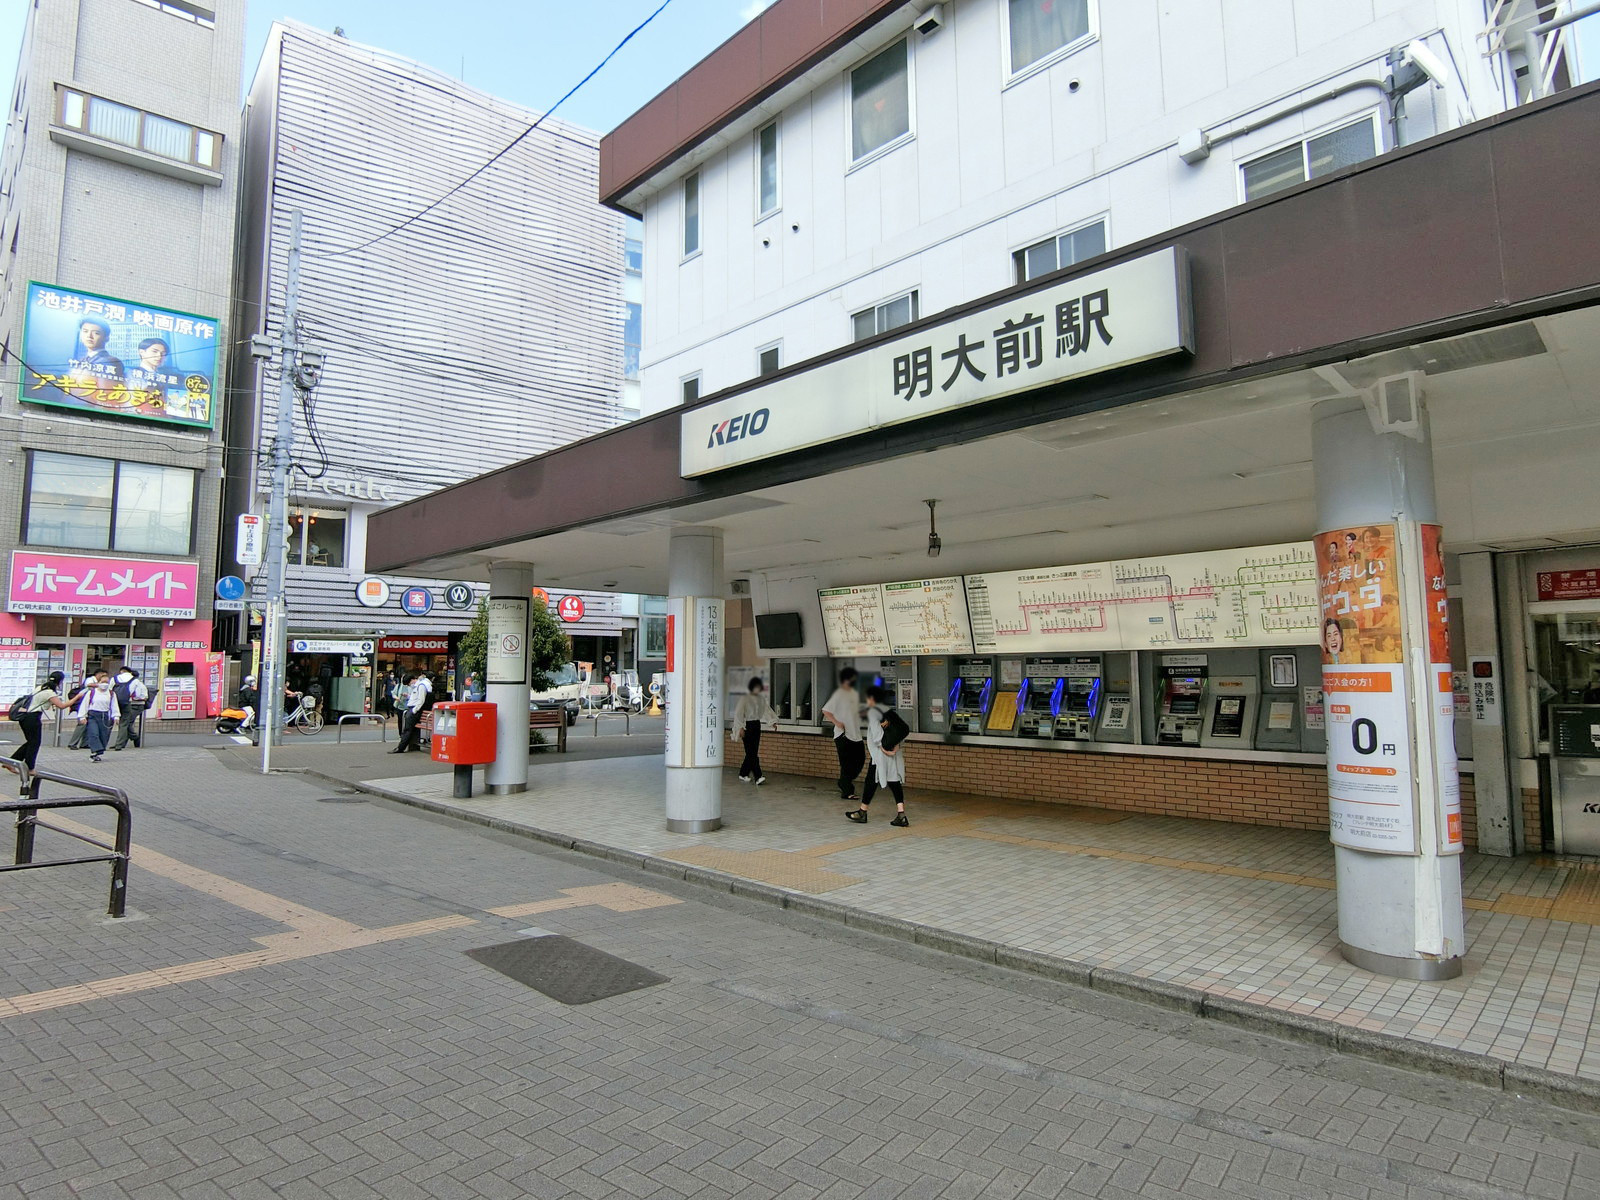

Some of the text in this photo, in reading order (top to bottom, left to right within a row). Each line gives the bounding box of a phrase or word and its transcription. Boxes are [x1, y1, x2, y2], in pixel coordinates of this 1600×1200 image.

[892, 287, 1114, 402] 明大前駅
[68, 358, 118, 375] 竹内涼真
[132, 369, 178, 385] 横浜流星
[32, 372, 164, 409] アキラとあきら
[706, 407, 770, 449] KEIO
[20, 563, 188, 600] ホームメイト
[411, 593, 425, 606] 本
[12, 603, 52, 611] FC明大前店
[136, 608, 192, 617] 03-6265-7741
[0, 637, 31, 646] 屋探し
[165, 640, 208, 649] お部屋探し
[1349, 829, 1372, 838] 明大前店
